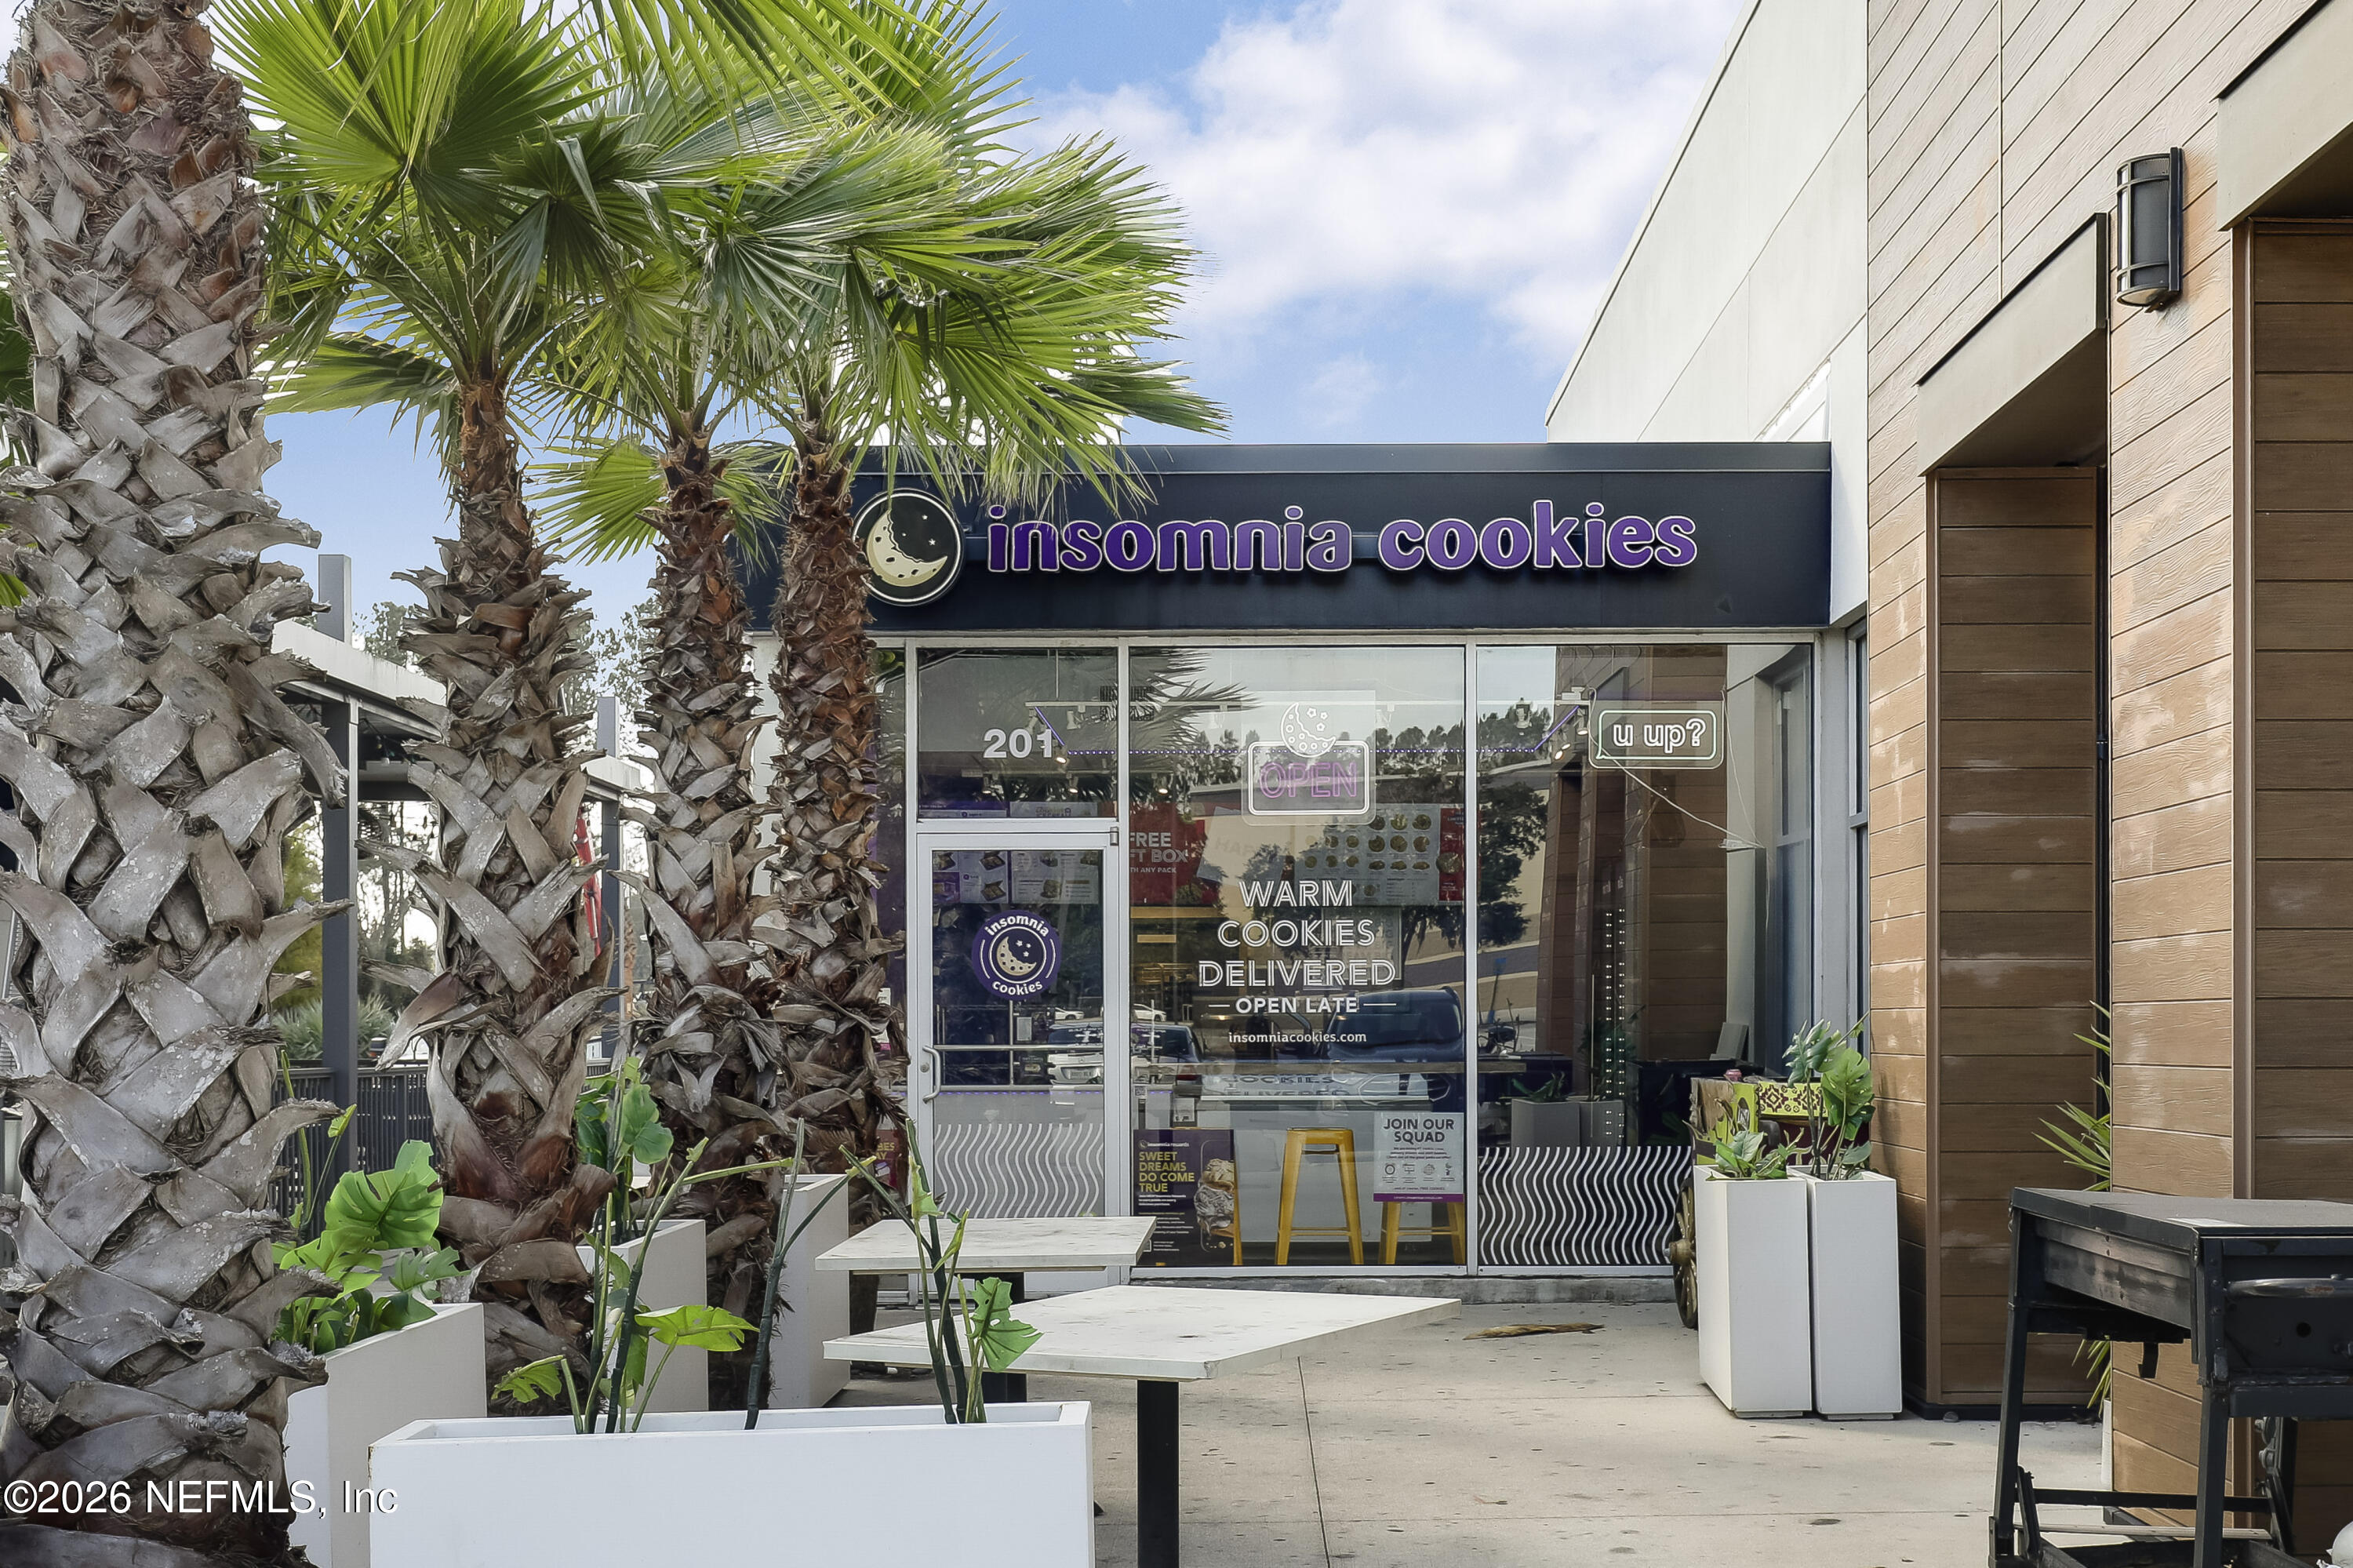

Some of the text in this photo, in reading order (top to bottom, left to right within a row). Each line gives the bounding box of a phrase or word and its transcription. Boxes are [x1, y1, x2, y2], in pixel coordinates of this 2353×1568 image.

[987, 499, 1697, 572] insomnia cookies
[983, 728, 1052, 759] 201
[1613, 718, 1707, 754] u up?
[1260, 762, 1357, 799] OPEN
[1151, 849, 1188, 863] BOX
[1238, 880, 1352, 907] WARM
[984, 915, 1049, 937] insomnia
[1217, 919, 1375, 947] COOKIES
[1198, 959, 1396, 987] DELIVERED
[992, 981, 1042, 995] cookies
[1235, 997, 1358, 1013] OPEN LATE
[1228, 1031, 1367, 1042] insomniacookies.com
[1384, 1119, 1454, 1130] JOIN OUR
[1394, 1131, 1445, 1144] SQUAD
[1139, 1151, 1177, 1161] SWEET
[1139, 1162, 1186, 1171] DREAMS
[1139, 1172, 1195, 1181] DO COME
[1139, 1183, 1168, 1192] TRUE
